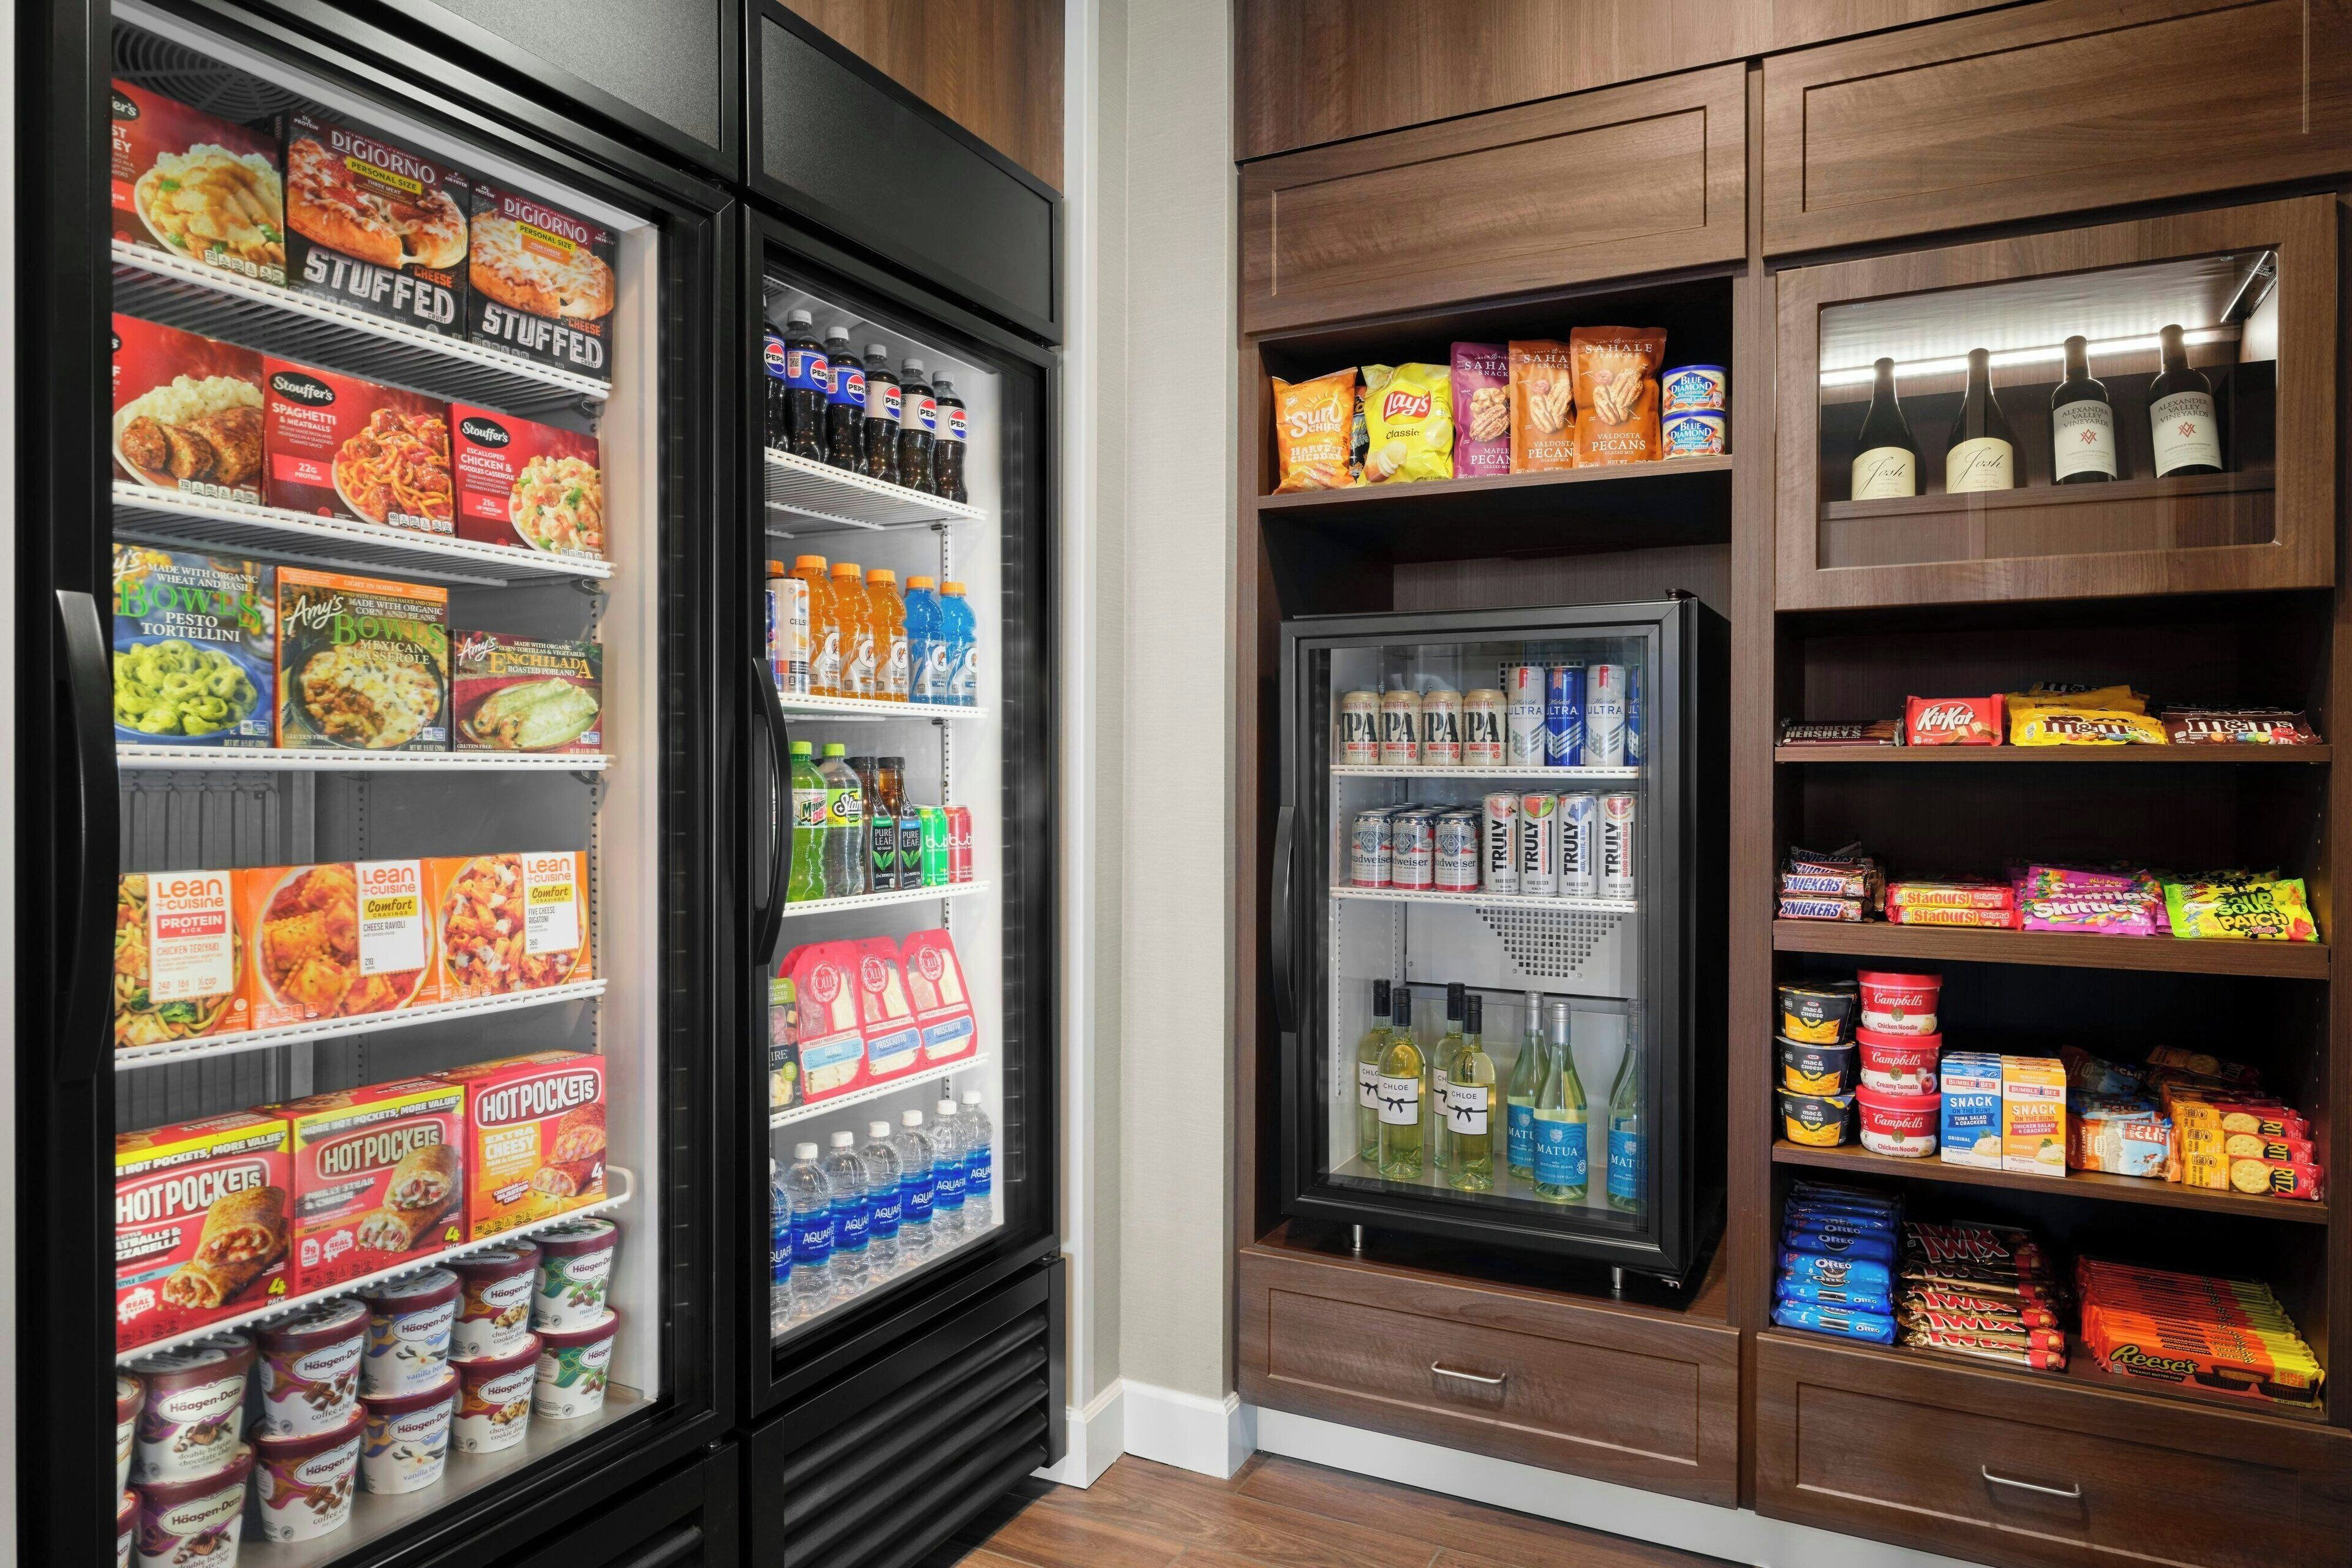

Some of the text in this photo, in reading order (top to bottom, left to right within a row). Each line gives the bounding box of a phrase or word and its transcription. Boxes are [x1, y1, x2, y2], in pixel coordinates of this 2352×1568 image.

[351, 162, 417, 190] PERSONAL SIZE
[368, 180, 401, 195] THREE MEAT
[520, 225, 572, 250] PERSONAL SIZE
[304, 246, 454, 324] STUFFED
[428, 312, 447, 323] CRUST
[482, 302, 603, 368] STUFFED
[1586, 344, 1653, 354] SAHALE
[581, 358, 597, 368] CRUST
[766, 353, 784, 363] PEPS
[1681, 376, 1702, 385] BLUE
[273, 375, 333, 401] Stouffer's
[1672, 382, 1713, 394] DIAMOND
[1385, 393, 1430, 417] Lay's
[2062, 406, 2108, 418] ALEXANDER
[2158, 398, 2209, 412] ALEXANDER
[2168, 404, 2200, 413] VALLEY
[272, 402, 336, 425] SPAGHETTI
[2160, 410, 2211, 423] VINEYARDS
[286, 417, 331, 432] MEATBALLS
[1680, 423, 1701, 431] BLUE
[2063, 418, 2109, 428] VINEYARDS
[462, 422, 509, 443] Stouffer's
[1671, 428, 1712, 440] DIAMOND
[1592, 440, 1645, 451] PECANS
[460, 455, 503, 471] CHICKEN
[294, 471, 322, 481] PROTEIN
[1854, 456, 1905, 499] Josh
[148, 563, 258, 584] MADE WITH ORGANIC
[157, 573, 251, 592] WHEAT AND BASIL
[118, 581, 262, 627] BOWLS
[349, 598, 443, 615] MADE WITH ORGANIC
[165, 612, 218, 627] PESTO
[141, 623, 240, 643] TORTELLINI
[331, 614, 447, 653] BOWLS
[489, 652, 594, 679] ENCHILADA
[507, 666, 575, 677] ROASTED POBLANO
[1509, 706, 1543, 715] ULTRA
[1588, 706, 1623, 714] ULTRA
[1785, 729, 1862, 738] HERSHEY'S
[875, 828, 893, 838] PURE
[1492, 820, 1507, 872] TRULY
[1525, 821, 1539, 873] TRULY
[1564, 821, 1578, 875] TRULY
[1605, 821, 1621, 876] TRULY
[1785, 876, 1842, 892] SNICKERS
[532, 887, 568, 898] Comfort
[1907, 892, 1972, 905] Starburst
[368, 898, 412, 913] Comfort
[1782, 902, 1842, 916] SNICKERS
[2034, 901, 2147, 918] Skittles
[2215, 902, 2276, 915] SOUR
[160, 915, 222, 929] PROTEIN
[1914, 910, 1978, 924] Starburst
[2222, 914, 2289, 926] PATCH
[363, 921, 405, 931] CHEESE RAVIOLI
[157, 943, 219, 956] CHICKEN TERIYAKI
[1874, 993, 1922, 1006] Campbell's
[933, 1022, 961, 1036] PROSCIUTTO
[876, 1035, 907, 1049] PROSCIUTTO
[824, 1045, 842, 1056] GENOA
[1871, 1051, 1921, 1066] Campbell's
[1384, 1082, 1408, 1091] CHLOE
[1948, 1079, 1974, 1087] BUMBLE
[1452, 1091, 1477, 1099] CHLOE
[2011, 1086, 2038, 1095] BUMBLE
[1950, 1096, 1993, 1107] SNACK
[2012, 1104, 2056, 1115] SNACK
[485, 1126, 535, 1142] EXTRA
[485, 1135, 534, 1158] CHEESY
[1537, 1142, 1578, 1156] MATUA
[592, 1162, 603, 1178] 4
[2274, 1167, 2295, 1194] RITZ
[443, 1226, 460, 1242] 4
[1817, 1234, 1854, 1245] OREO
[330, 1238, 349, 1248] REAL
[1915, 1235, 2009, 1264] TWIX
[579, 1308, 594, 1316] mint
[1855, 1325, 1880, 1333] OREO
[1928, 1312, 2025, 1332] TWIX
[2110, 1344, 2198, 1374] Reese's
[2280, 1371, 2305, 1380] KING
[2280, 1378, 2304, 1387] SIZE
[170, 1385, 241, 1413] Häagen-Dazs
[312, 1402, 351, 1420] coffee chip
[403, 1460, 442, 1482] vanilla bean
[172, 1495, 241, 1526] Häagen-Dazs
